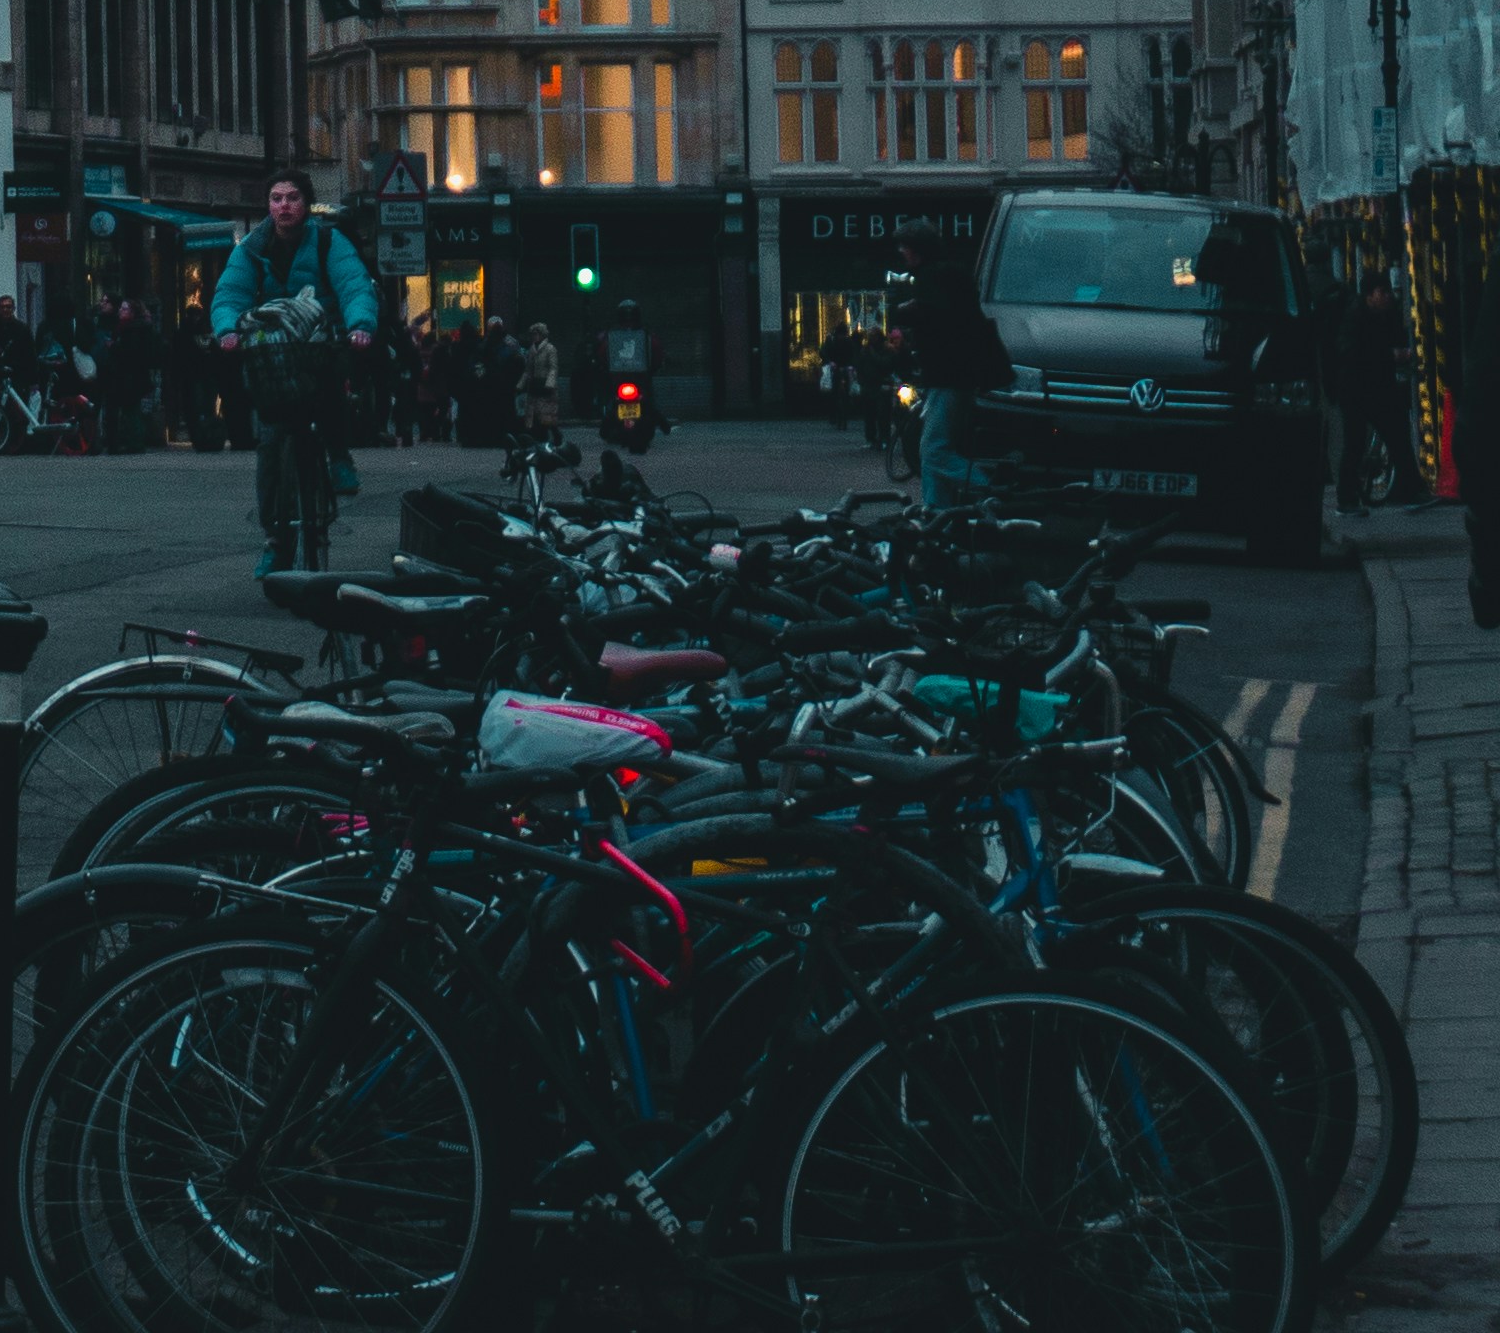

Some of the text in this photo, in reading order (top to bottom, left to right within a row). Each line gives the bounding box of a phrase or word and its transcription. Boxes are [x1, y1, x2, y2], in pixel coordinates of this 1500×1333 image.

[444, 280, 482, 294] BRING
[444, 294, 482, 310] IT ON
[624, 1169, 682, 1237] PLUG
